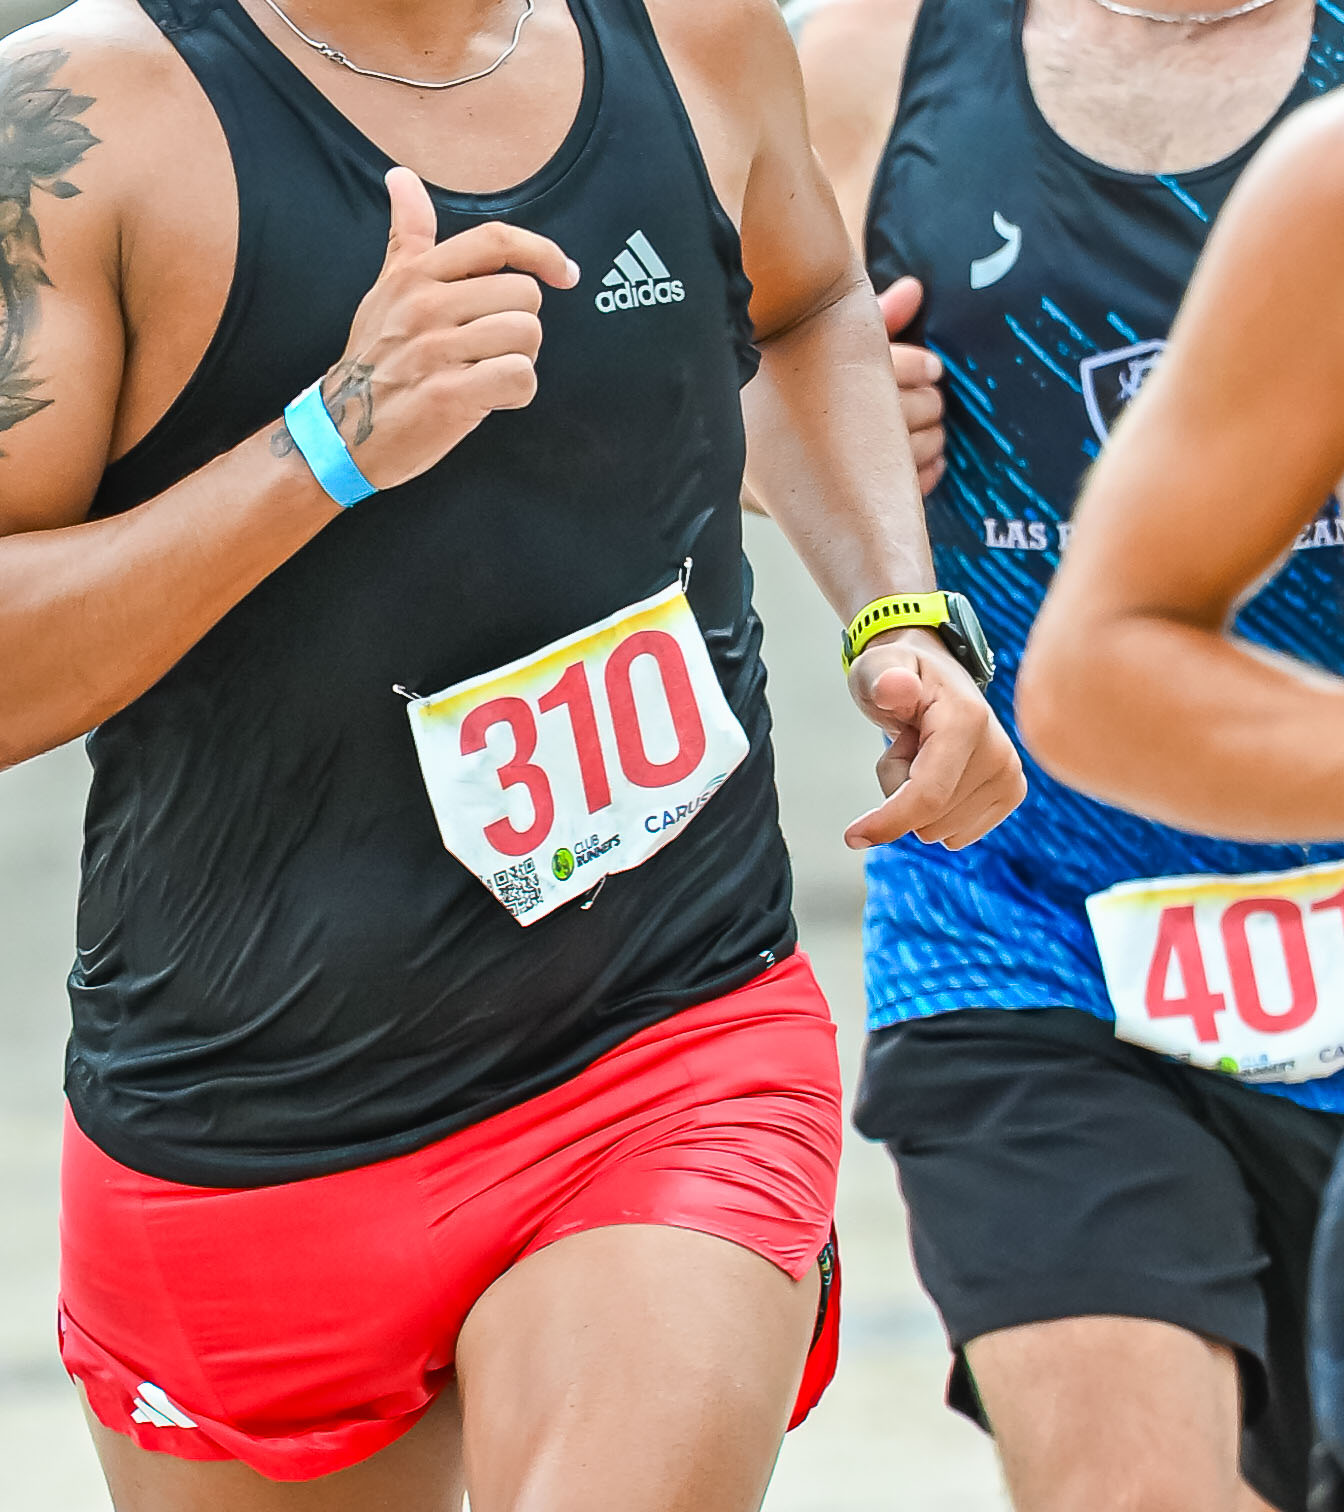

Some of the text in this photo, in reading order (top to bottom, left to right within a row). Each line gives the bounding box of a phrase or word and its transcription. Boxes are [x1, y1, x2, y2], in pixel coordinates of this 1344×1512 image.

[595, 278, 685, 313] adidas
[983, 518, 1048, 550] LAS
[459, 630, 706, 857] 310
[645, 784, 722, 833] CARUS
[574, 834, 599, 854] CLUB
